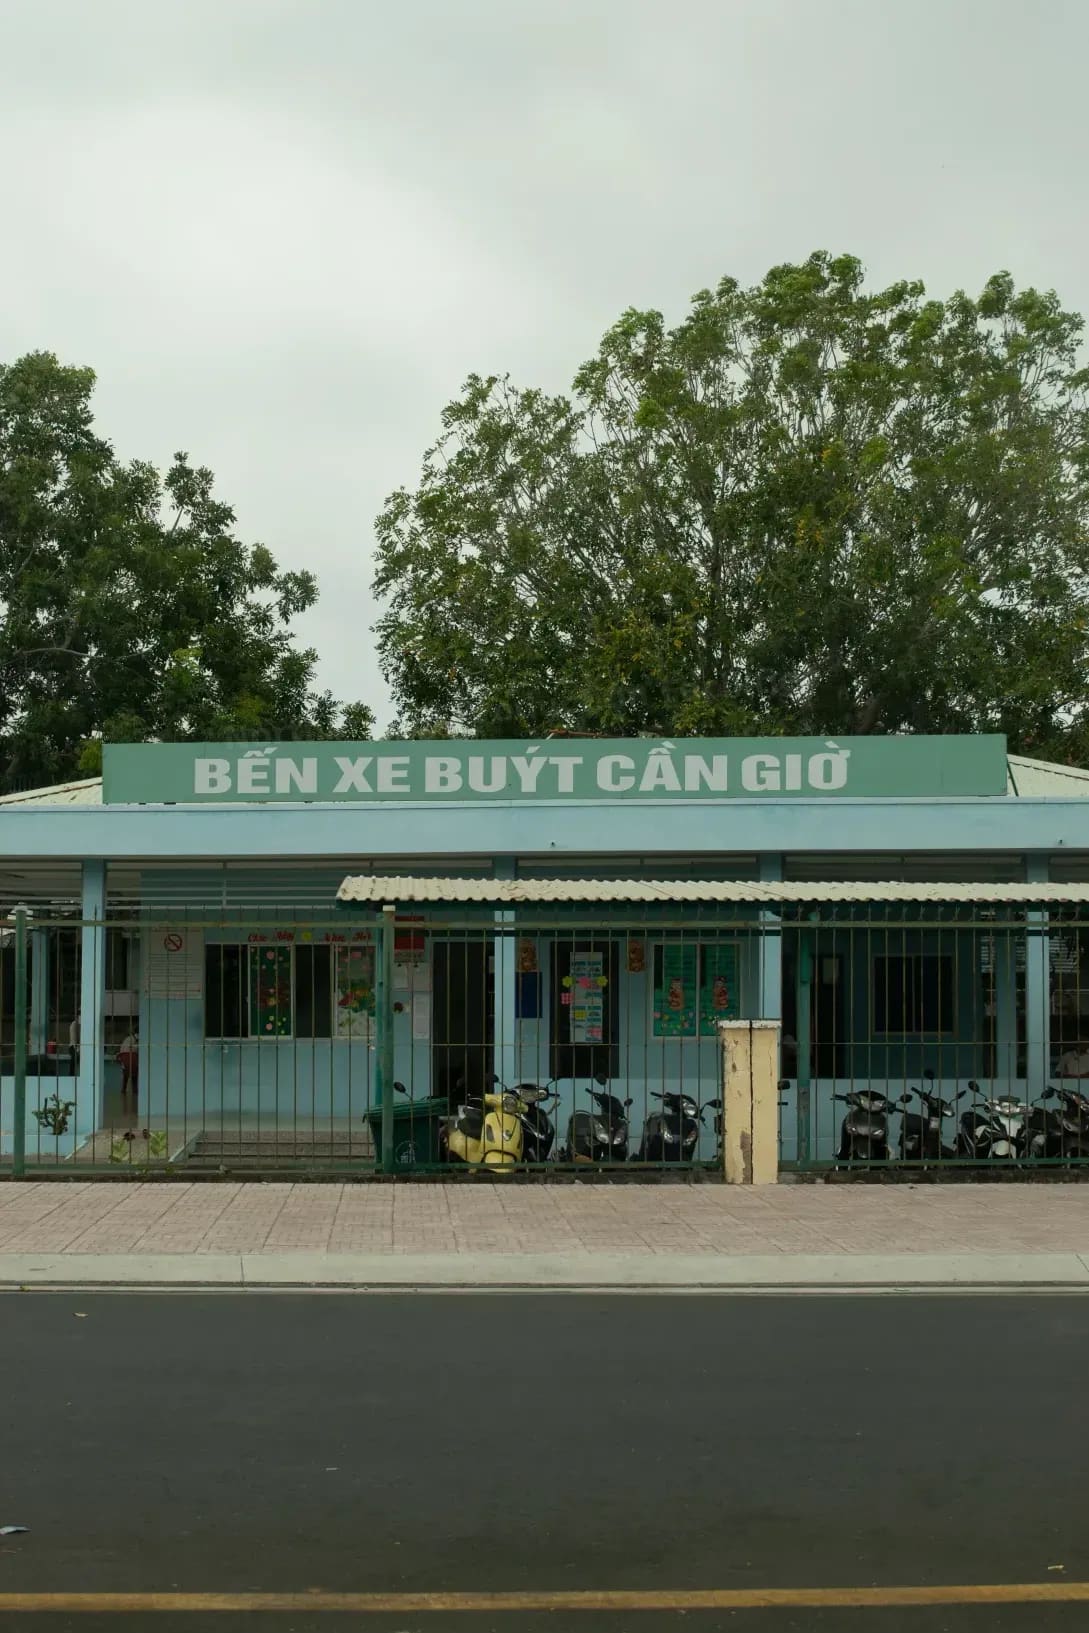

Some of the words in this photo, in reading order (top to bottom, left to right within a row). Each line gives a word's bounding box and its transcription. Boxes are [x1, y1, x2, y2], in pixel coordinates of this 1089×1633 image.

[194, 747, 318, 794] BẾN
[332, 756, 411, 793] XE
[424, 745, 583, 793] BUÝT
[596, 740, 728, 792] CẦN
[741, 740, 851, 792] GIỜ
